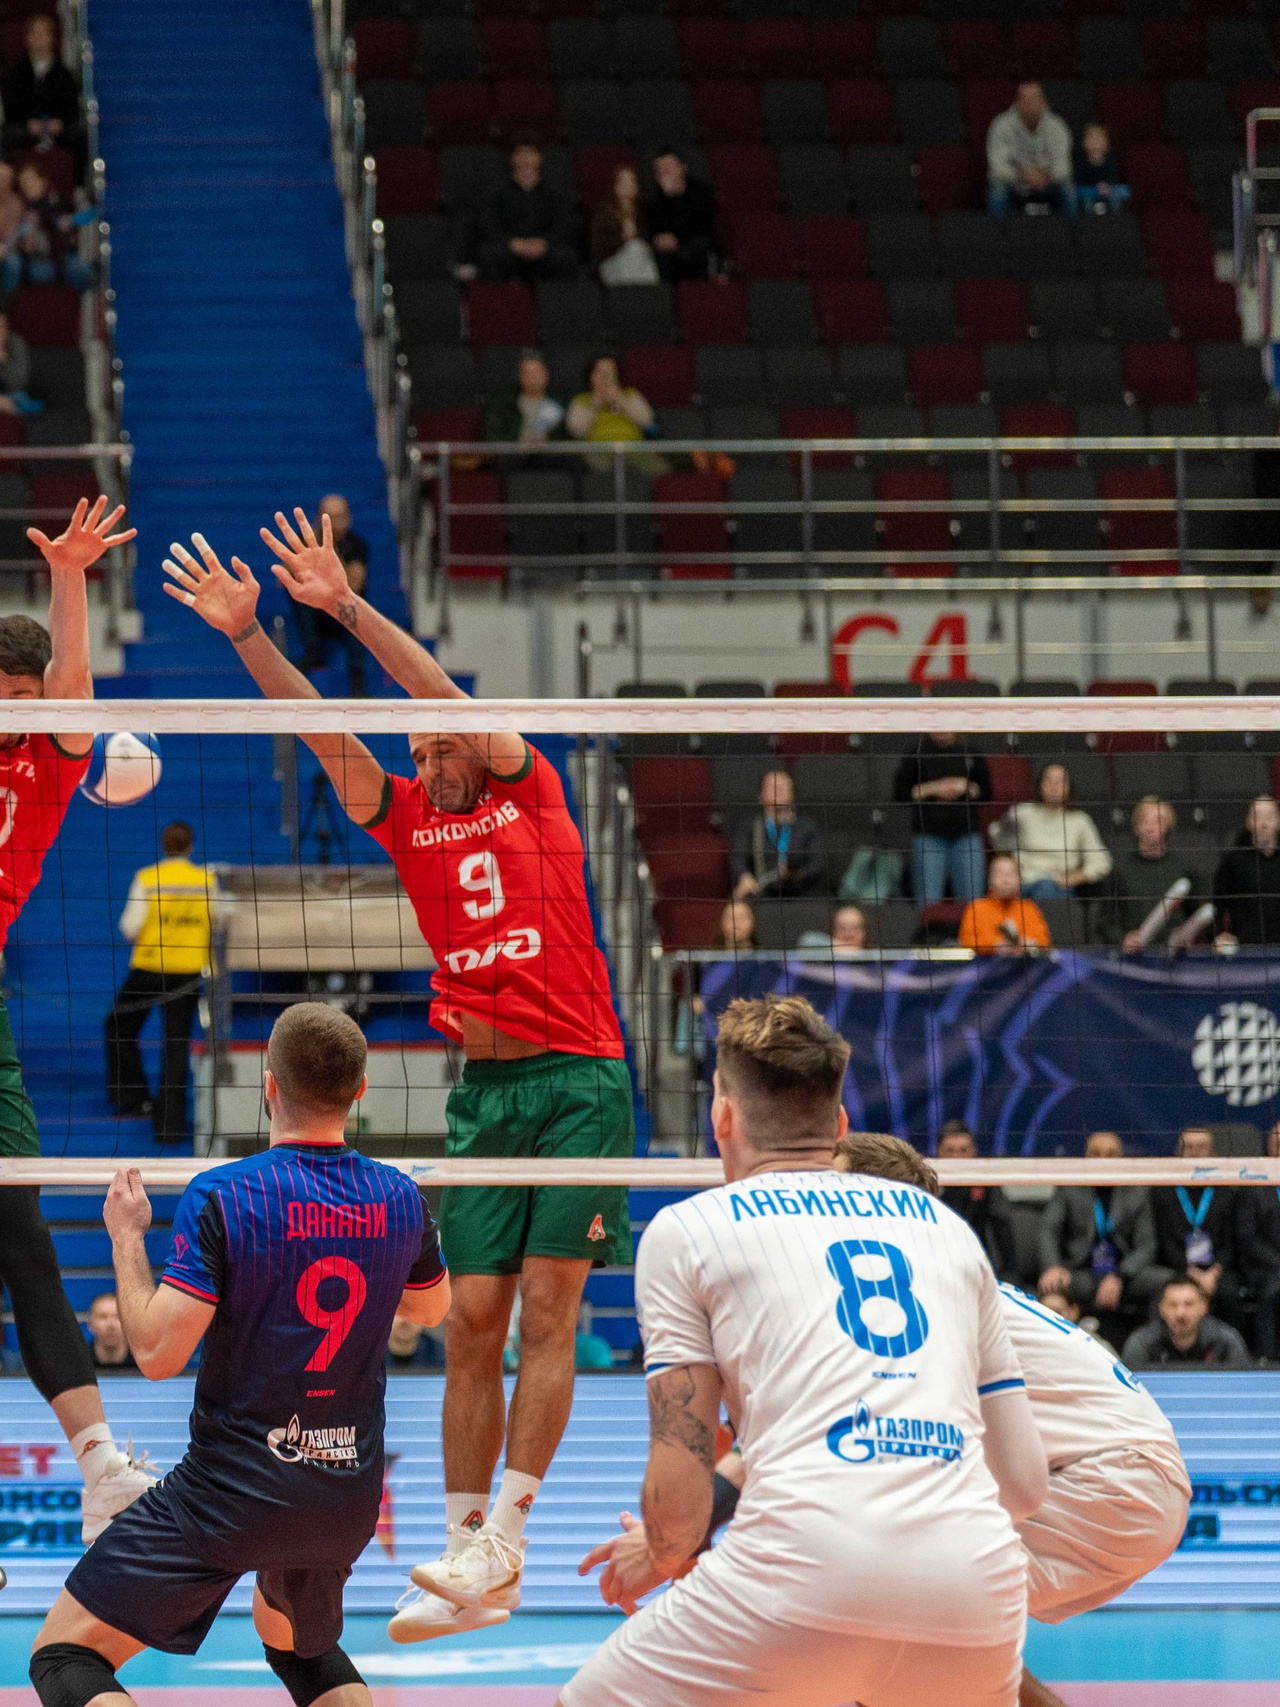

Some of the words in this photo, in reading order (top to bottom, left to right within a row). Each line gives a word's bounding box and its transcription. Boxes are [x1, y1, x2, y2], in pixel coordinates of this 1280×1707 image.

[458, 850, 506, 921] 9
[286, 1201, 387, 1241] ДАНАНИ
[296, 1256, 367, 1373] 9
[826, 1240, 929, 1359] 8
[306, 1389, 336, 1398] ENSEN
[300, 1426, 356, 1449] ГАЗПРОМ
[875, 1416, 964, 1450] ГАЗПРОМ
